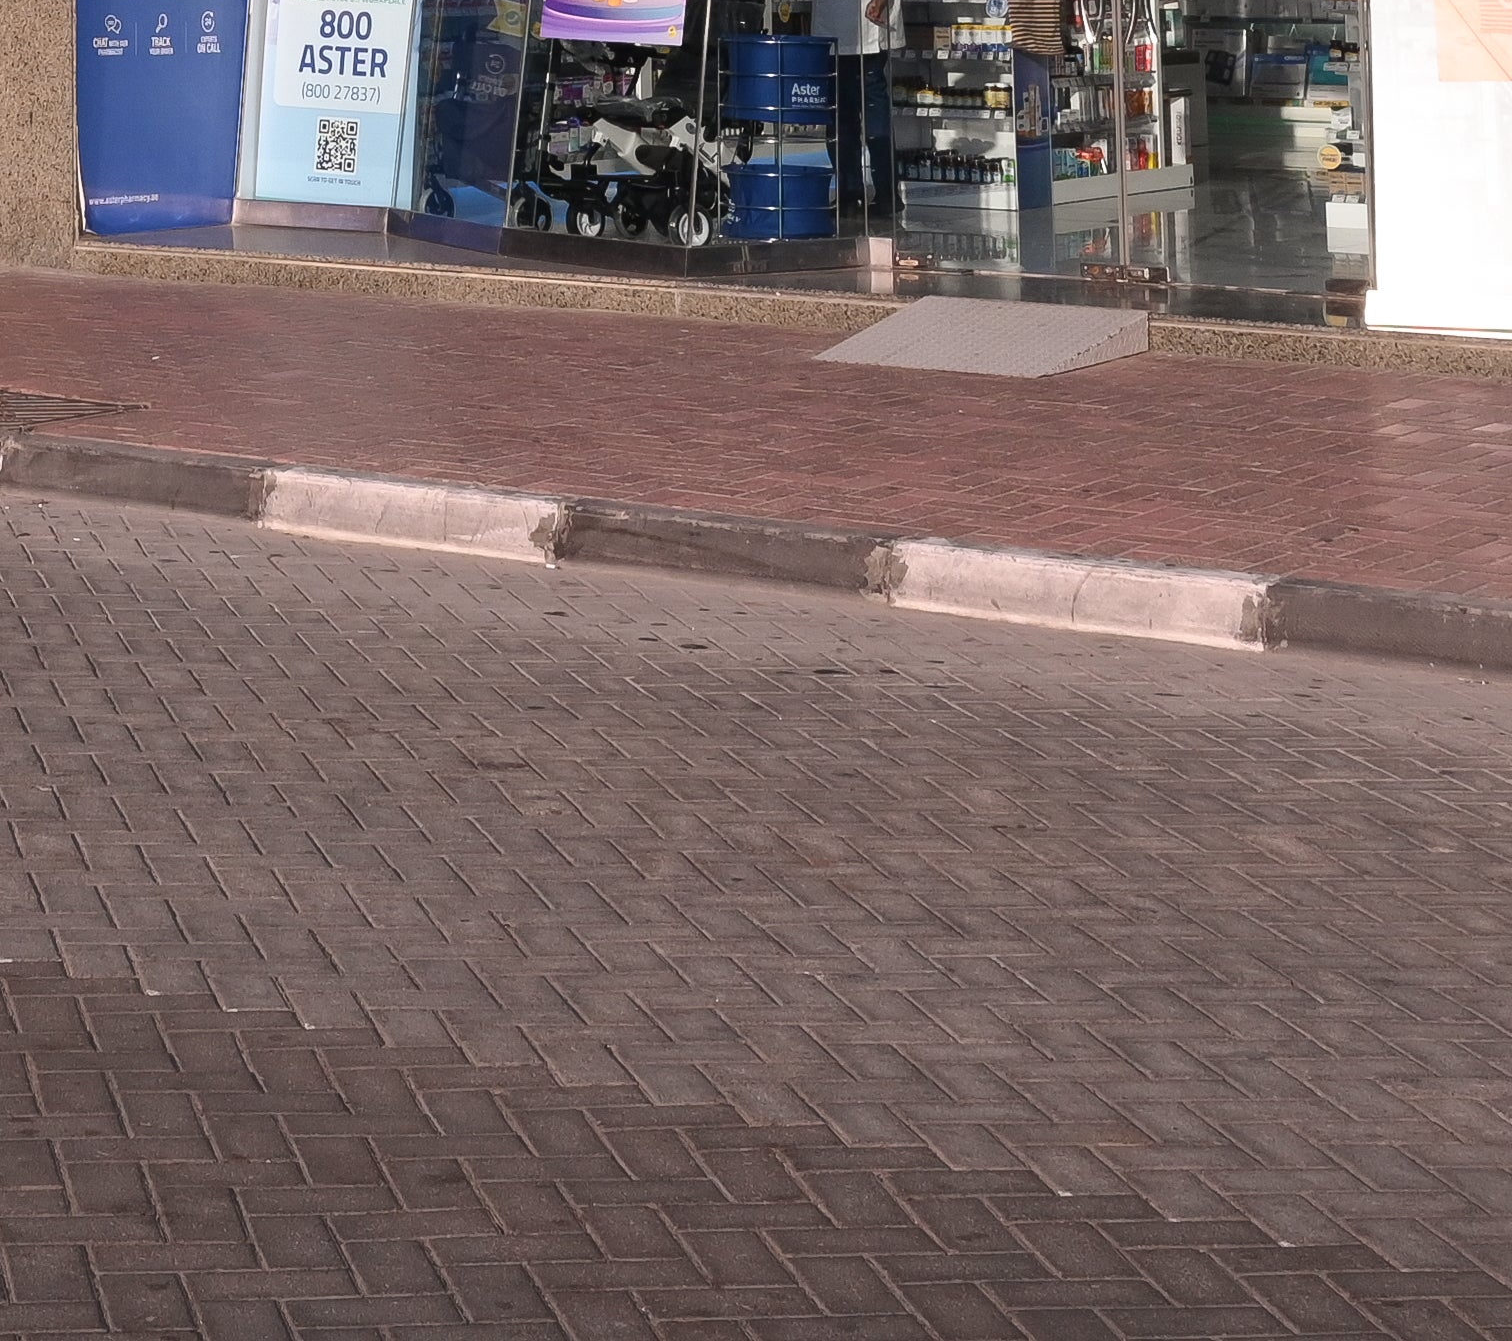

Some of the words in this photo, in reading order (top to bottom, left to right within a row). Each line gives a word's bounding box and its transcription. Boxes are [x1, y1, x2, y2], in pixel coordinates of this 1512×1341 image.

[320, 10, 372, 40] 800
[151, 37, 171, 47] TRACK
[206, 42, 221, 54] CALL
[299, 44, 389, 78] ASTER
[302, 82, 330, 100] (800
[334, 84, 381, 105] 27837)
[792, 82, 821, 96] Aster
